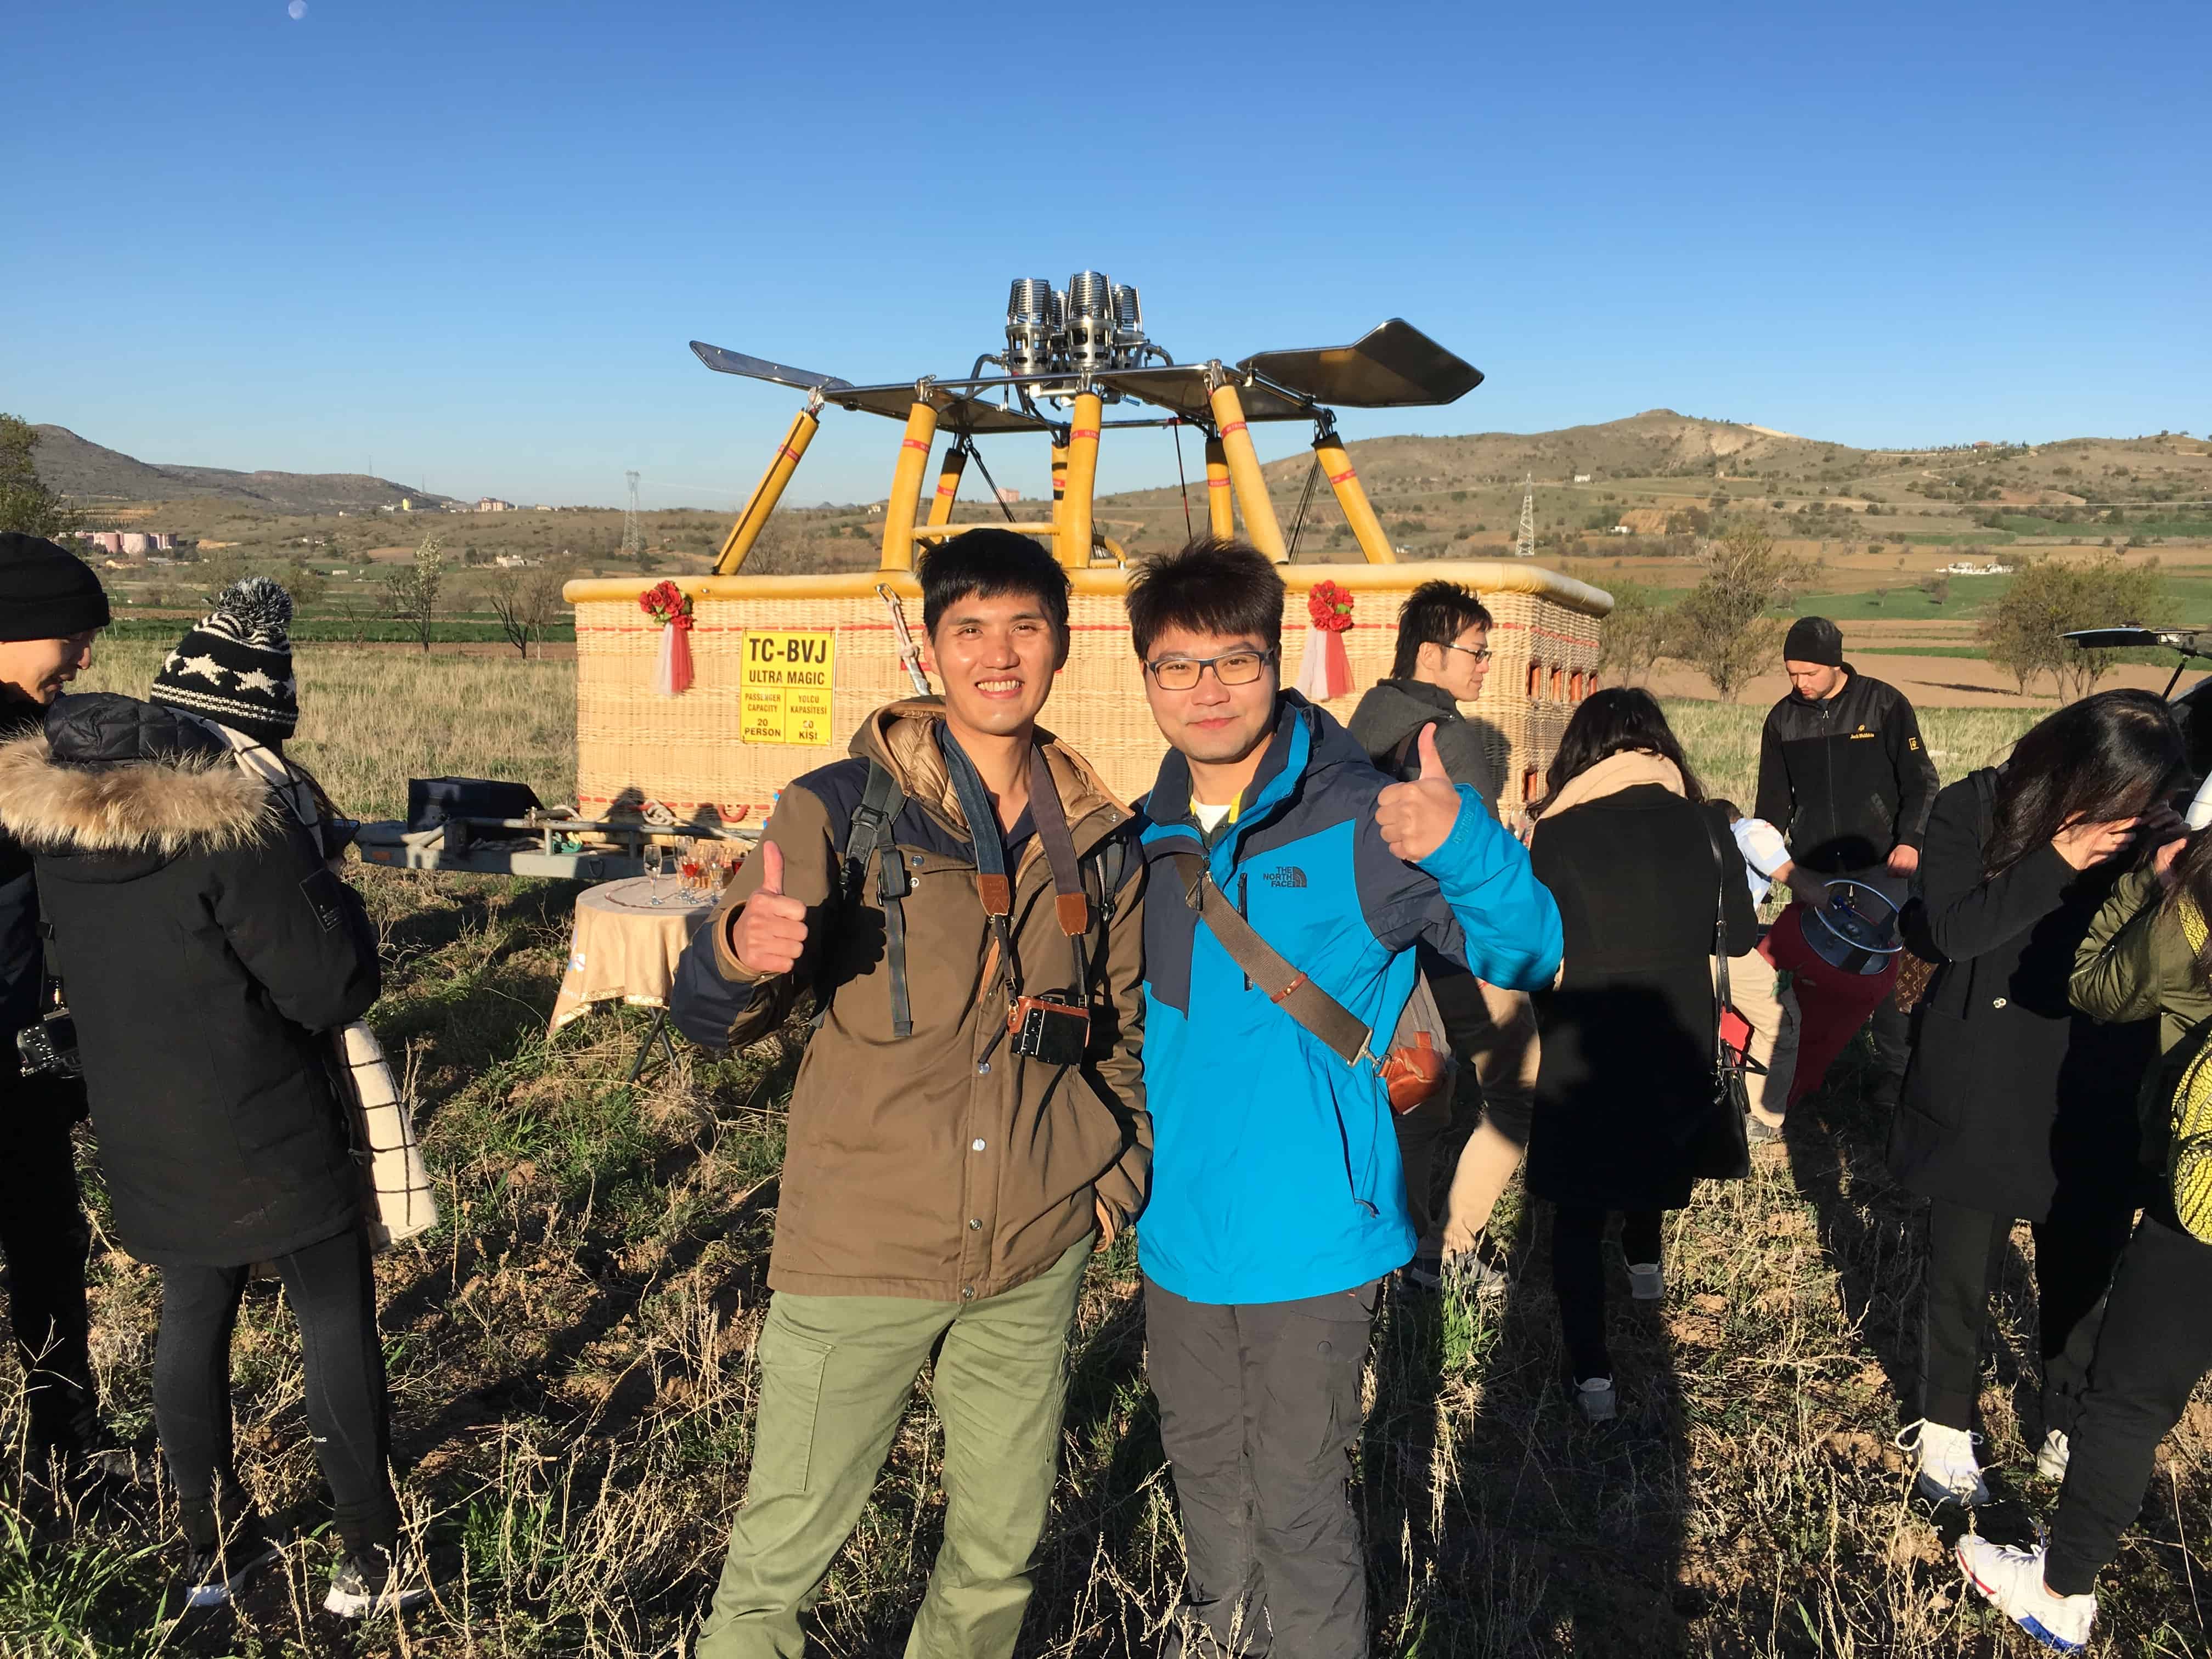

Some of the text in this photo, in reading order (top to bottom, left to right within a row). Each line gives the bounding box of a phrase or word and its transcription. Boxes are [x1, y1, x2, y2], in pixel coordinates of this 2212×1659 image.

[749, 638, 827, 664] TC-BVJ
[749, 670, 825, 685] ULTRA MAGIC
[745, 693, 781, 702] PASSENGER
[799, 695, 819, 703] YOLCU
[748, 704, 777, 713] CAPACITY
[744, 727, 781, 736] PERSON
